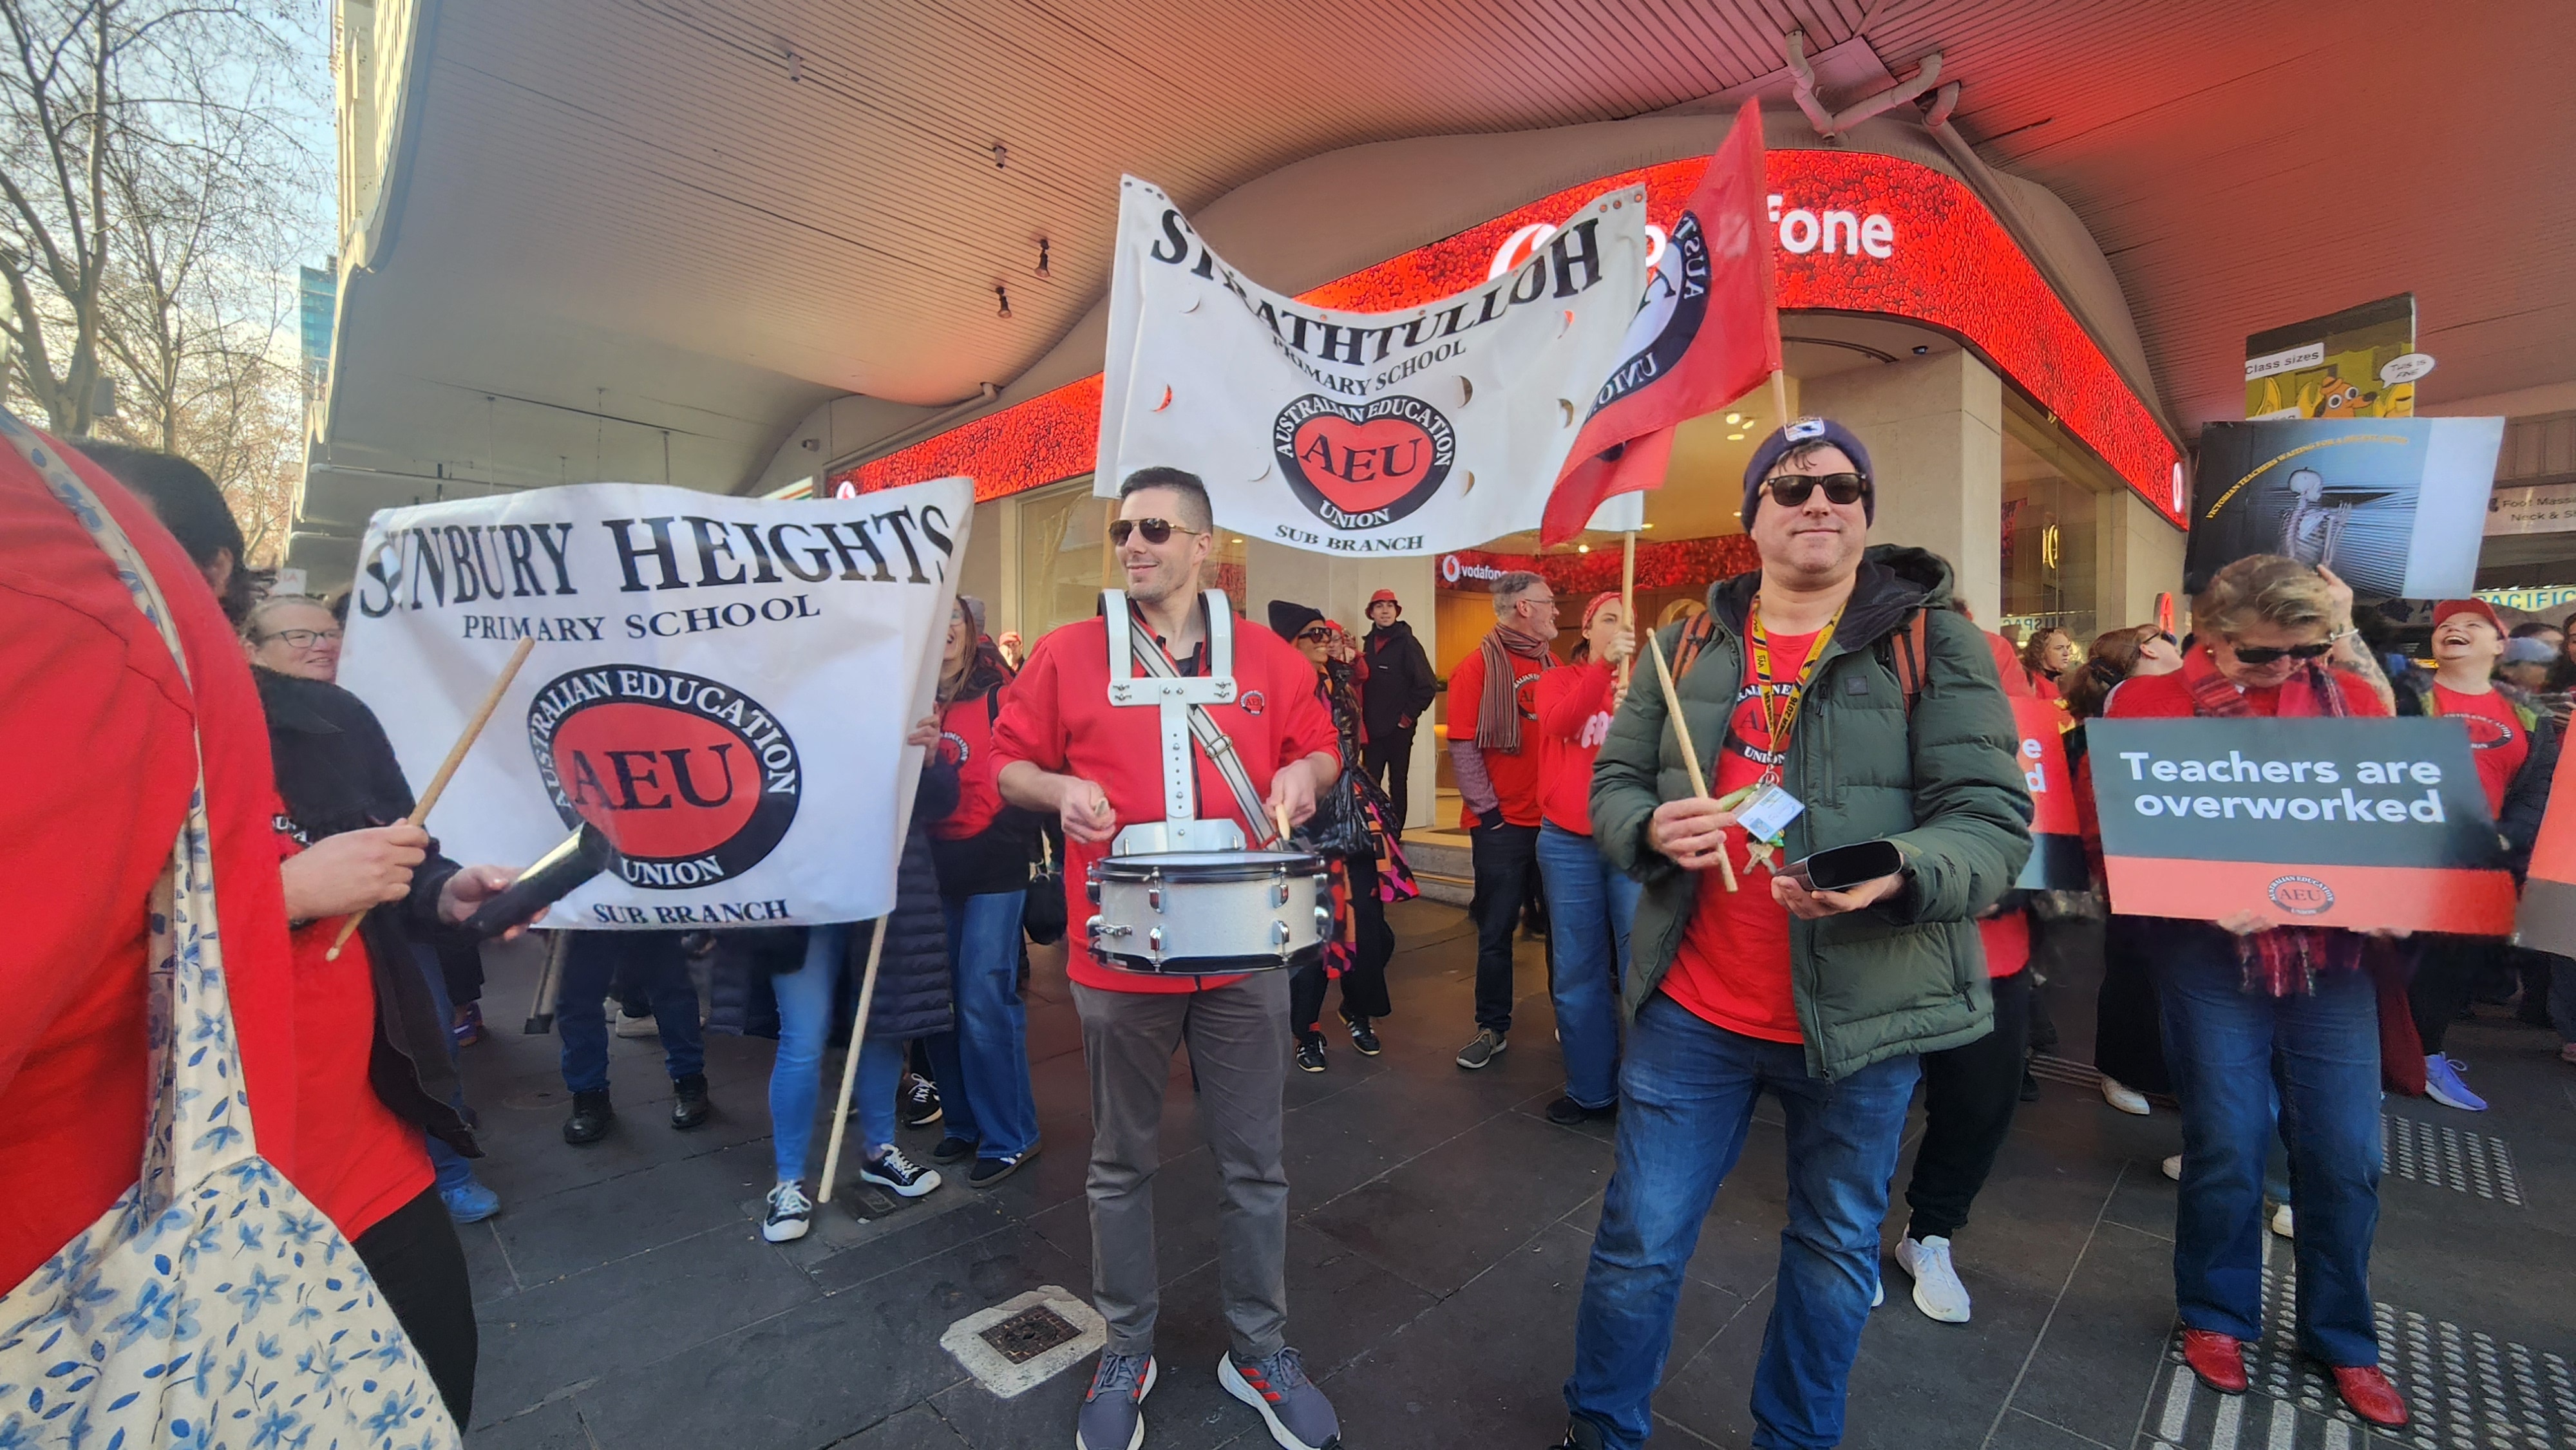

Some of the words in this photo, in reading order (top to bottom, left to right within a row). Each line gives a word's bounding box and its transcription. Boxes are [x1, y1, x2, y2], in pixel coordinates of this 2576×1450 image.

[1272, 334, 1372, 396] PRIMARY
[1376, 339, 1466, 391] SCHOOL
[2246, 361, 2280, 375] Class
[2284, 352, 2319, 367] sizes
[1276, 397, 1364, 458] AUSTRALIAN
[1366, 399, 1453, 466] EDUCATION
[1300, 433, 1423, 483] AEU
[2205, 483, 2241, 519] VICTORIAN
[2238, 458, 2278, 485] TEACHERS
[1319, 500, 1390, 528] UNION
[2511, 512, 2545, 522] Neck
[601, 505, 954, 592] HEIGHTS
[1274, 525, 1319, 545] SUB
[1325, 535, 1424, 552] BRANCH
[462, 615, 604, 641] PRIMARY
[625, 594, 820, 639] SCHOOL
[1785, 695, 1798, 718] 2016
[531, 671, 612, 809] AUSTRALIAN
[618, 670, 796, 795] EDUCATION
[571, 743, 733, 810] AEU
[2119, 751, 2339, 783] Teachers
[2356, 760, 2442, 784] are
[2135, 788, 2446, 823] overworked
[621, 856, 724, 885] UNION
[2280, 889, 2321, 901] AEU
[2297, 876, 2334, 901] EDUCATION
[592, 903, 649, 924] SUB
[652, 899, 792, 924] BRANCH
